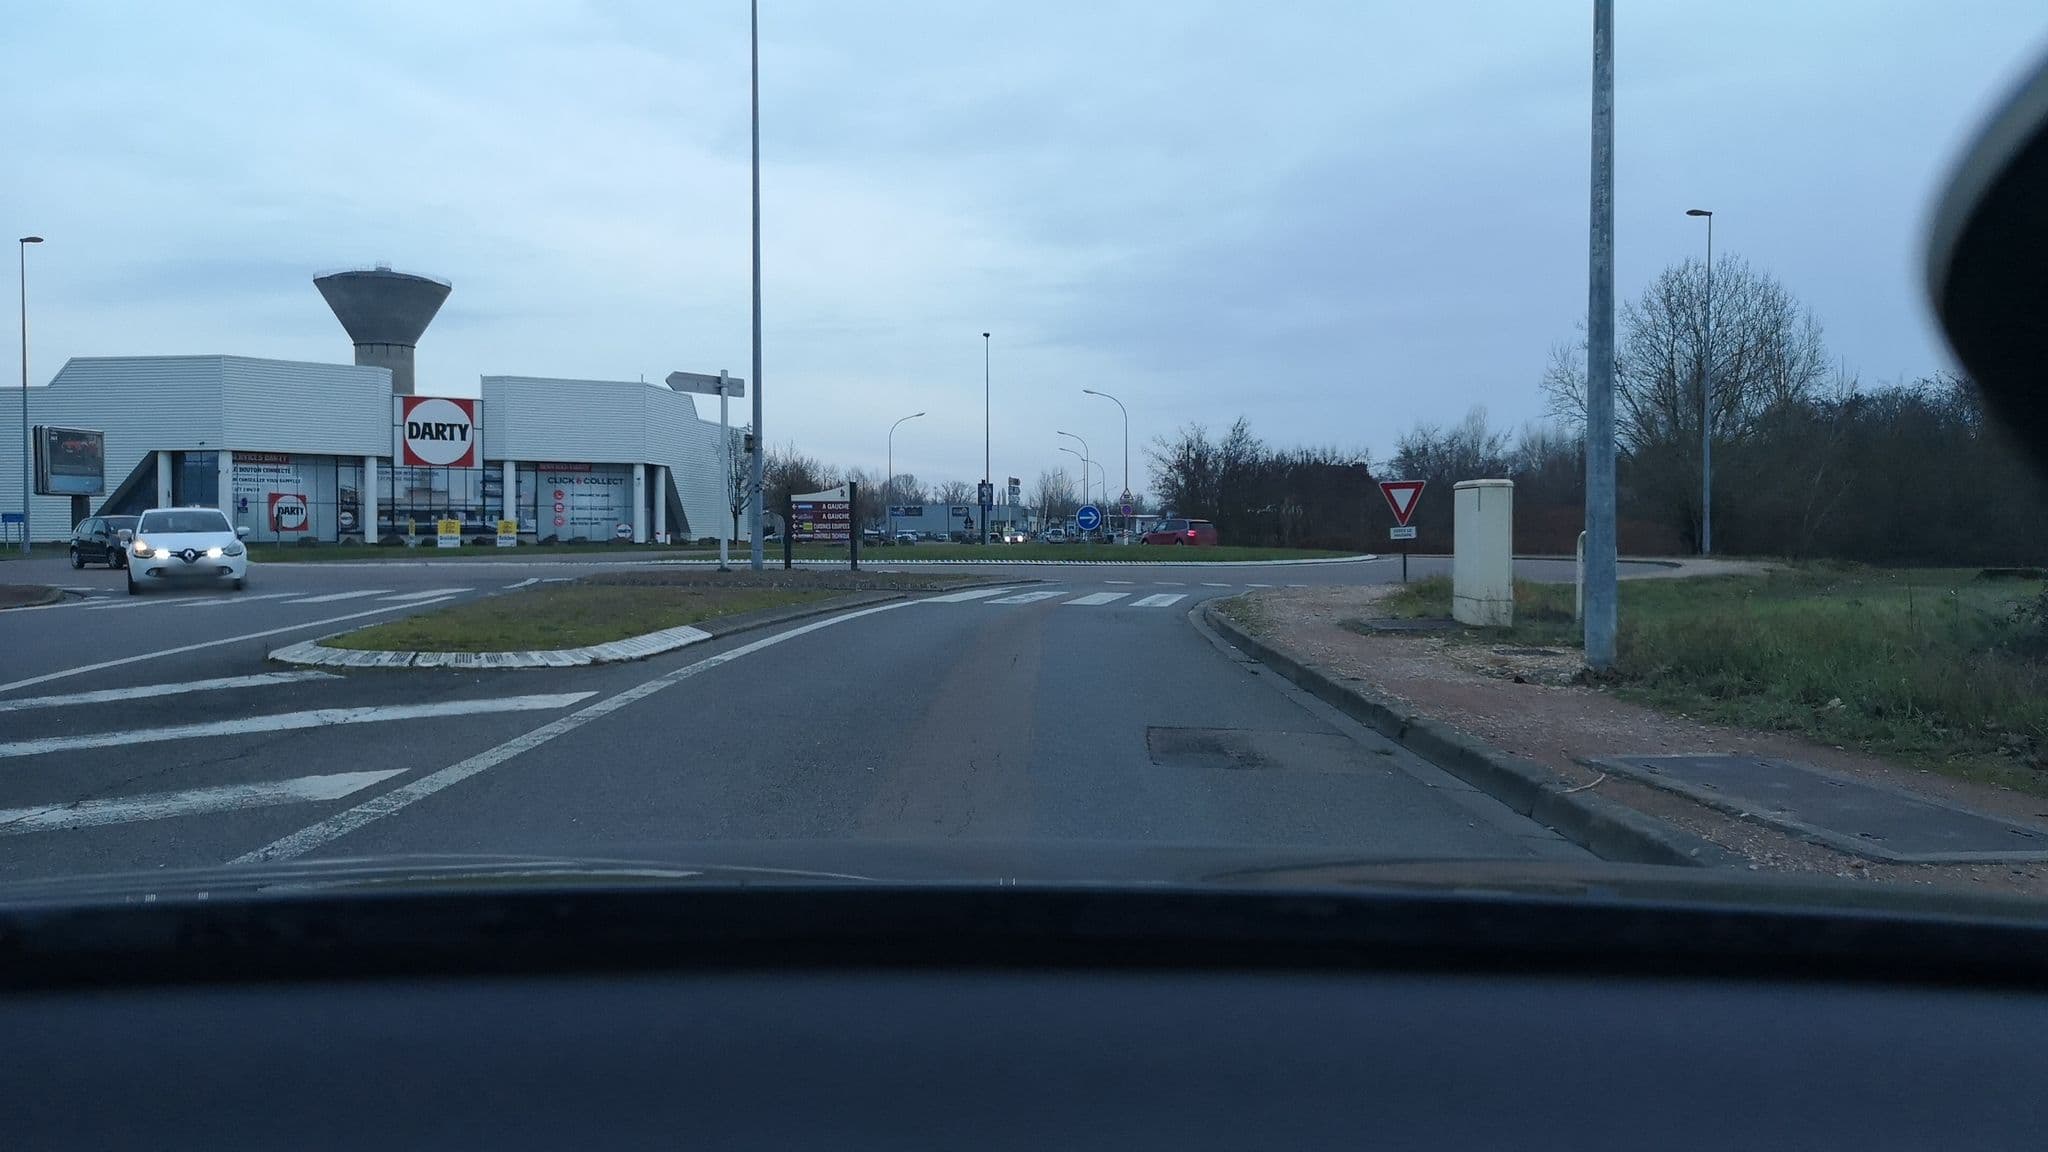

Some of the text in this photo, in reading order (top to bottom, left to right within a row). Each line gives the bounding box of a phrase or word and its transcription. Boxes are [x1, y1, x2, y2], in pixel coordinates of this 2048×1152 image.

[408, 422, 470, 441] DARTY
[583, 477, 624, 485] COLLECT
[278, 507, 304, 515] DARTY
